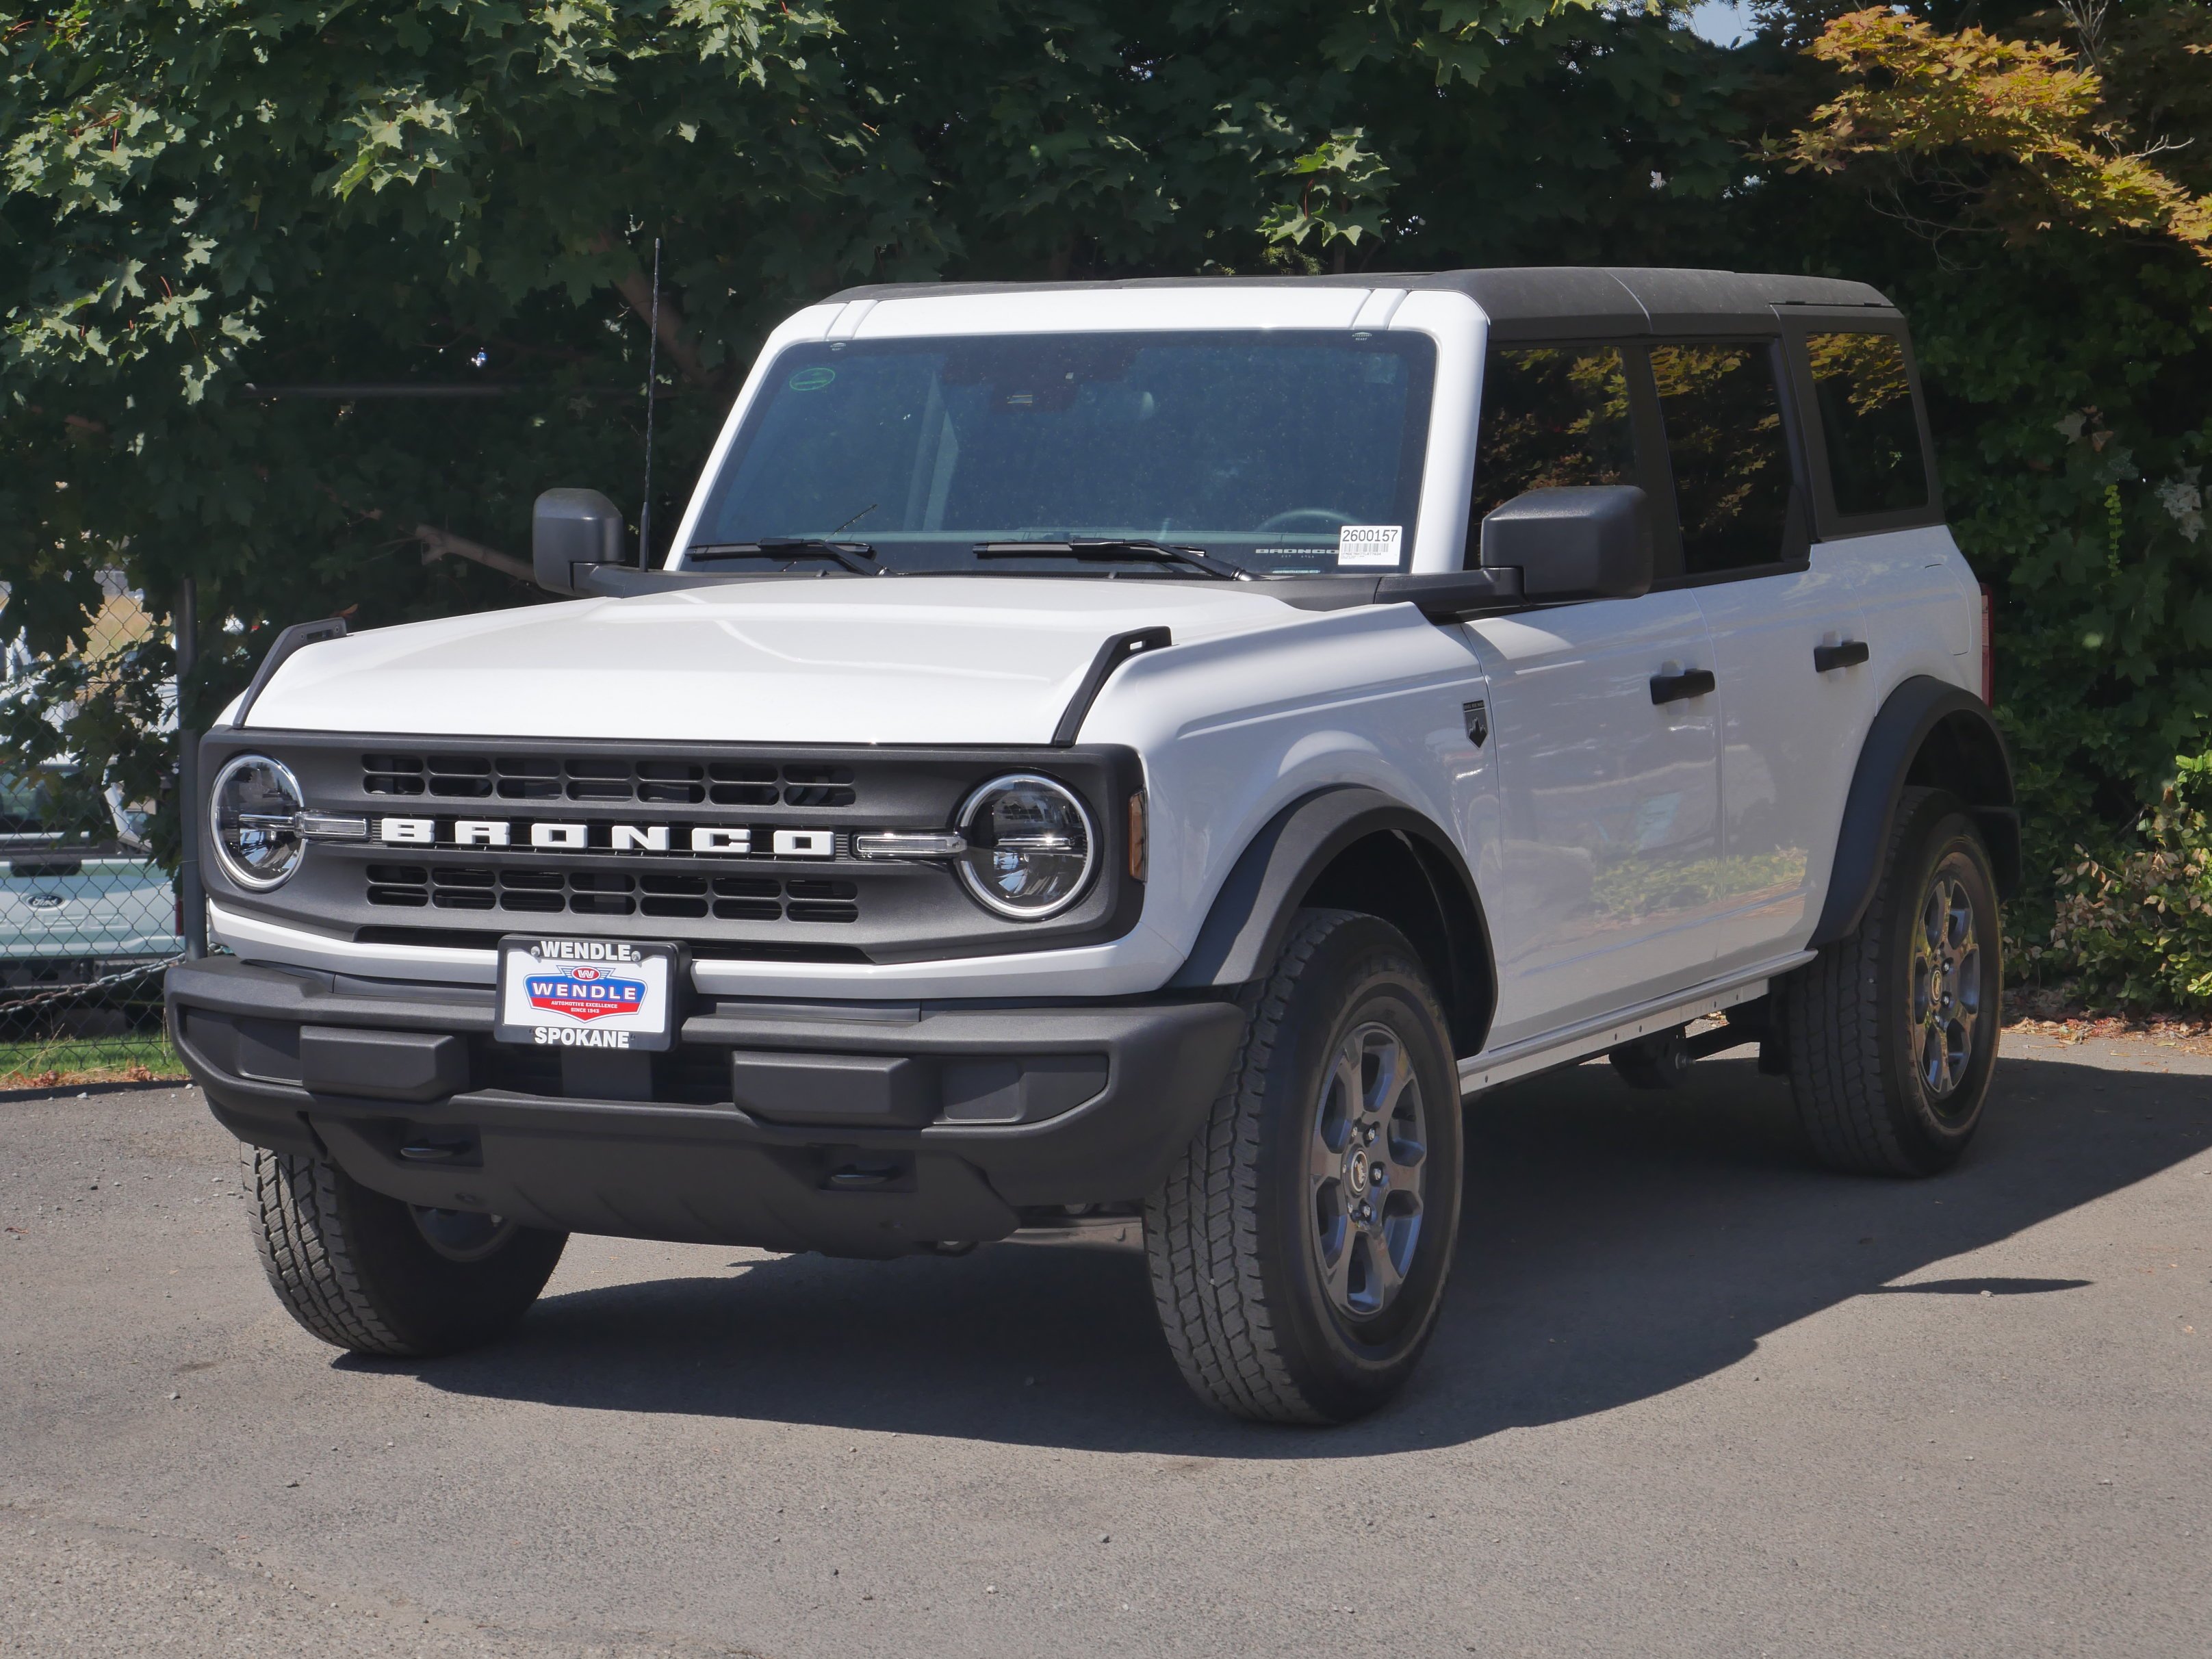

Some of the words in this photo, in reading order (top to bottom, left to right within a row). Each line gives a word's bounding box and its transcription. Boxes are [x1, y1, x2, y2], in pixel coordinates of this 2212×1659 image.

[1342, 530, 1398, 541] 2600157
[381, 818, 835, 856] BRONCO
[540, 940, 631, 961] WENDLE
[532, 983, 636, 1000] WENDLE
[535, 1027, 629, 1049] SPOKANE
